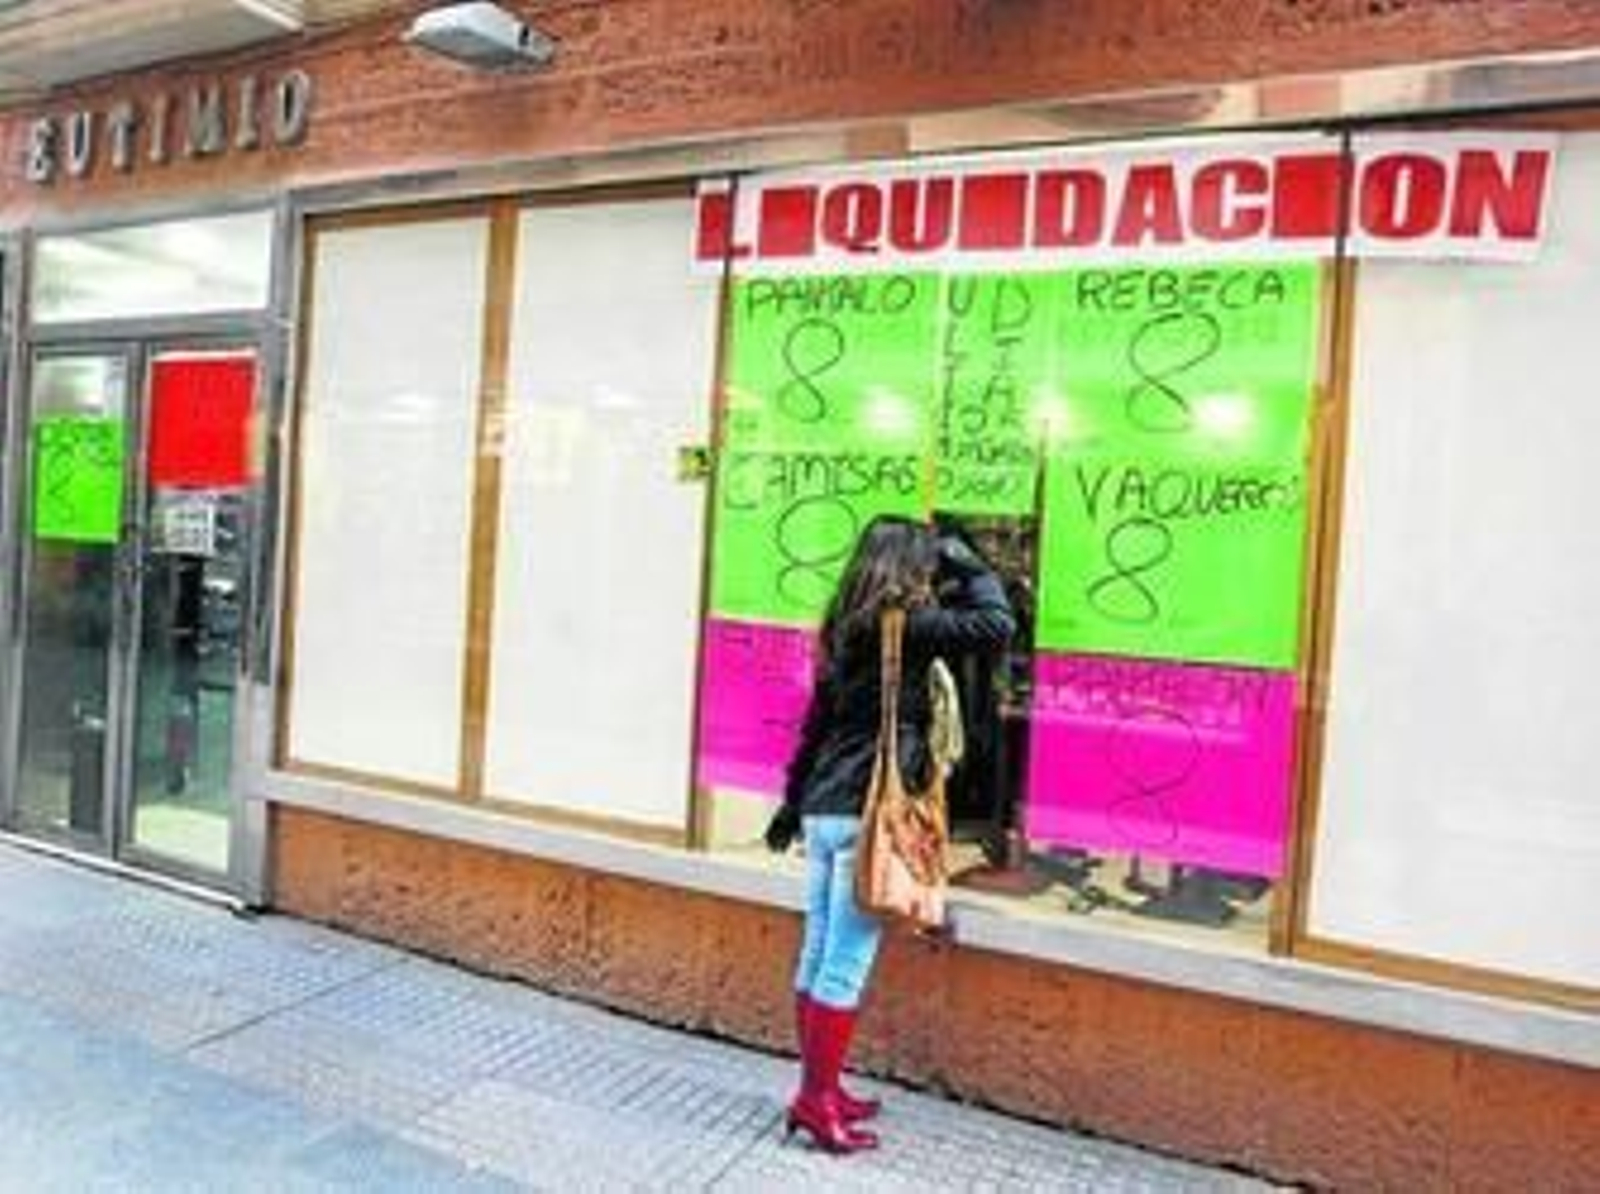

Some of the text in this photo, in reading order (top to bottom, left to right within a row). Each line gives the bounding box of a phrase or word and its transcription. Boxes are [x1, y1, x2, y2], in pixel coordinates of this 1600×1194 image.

[25, 70, 310, 182] EUTIMIO
[1077, 270, 1285, 311] REBECA
[776, 317, 846, 424] 8
[1125, 312, 1222, 433] 8
[1086, 517, 1173, 624] 8
